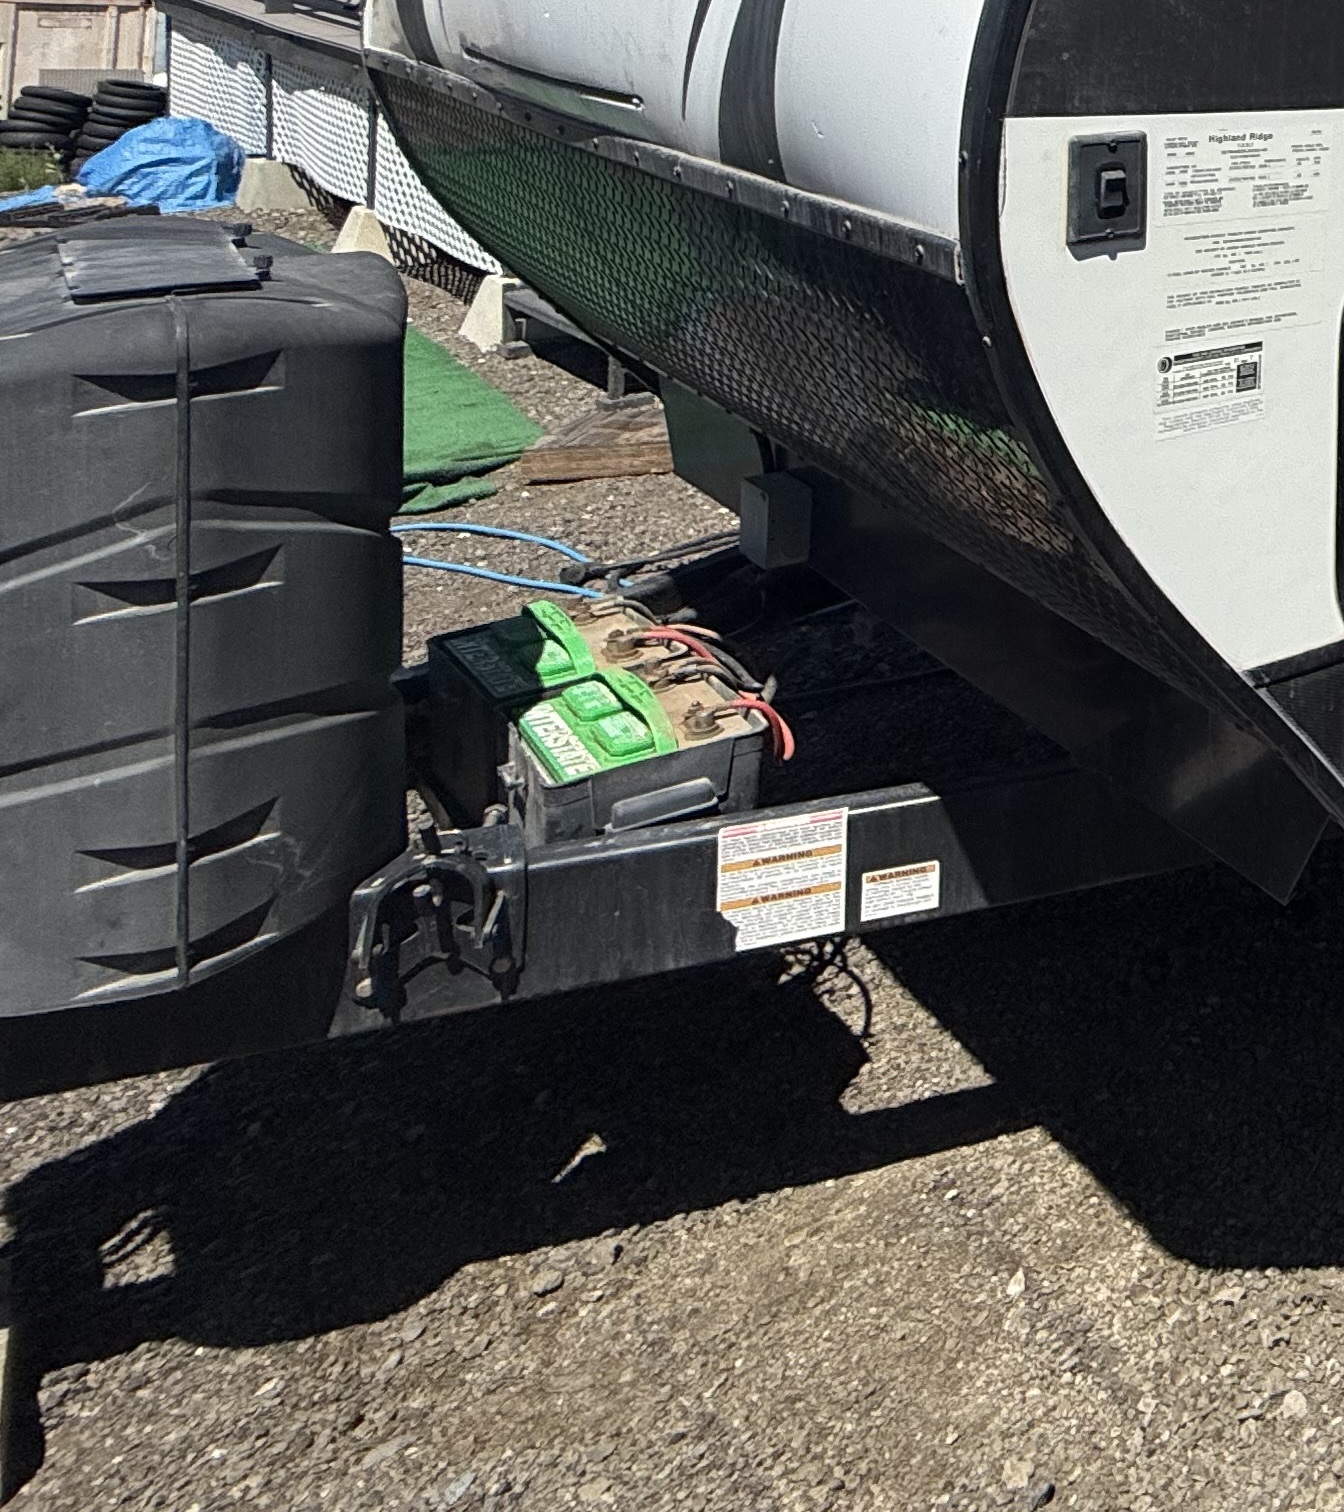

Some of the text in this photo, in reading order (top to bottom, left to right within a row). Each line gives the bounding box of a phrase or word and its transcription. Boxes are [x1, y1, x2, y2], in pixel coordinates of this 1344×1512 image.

[1208, 133, 1246, 144] Highland
[1249, 132, 1274, 141] Ridge
[761, 849, 813, 866] WARNING
[879, 866, 927, 881] WARNING
[760, 887, 812, 904] WARNING
